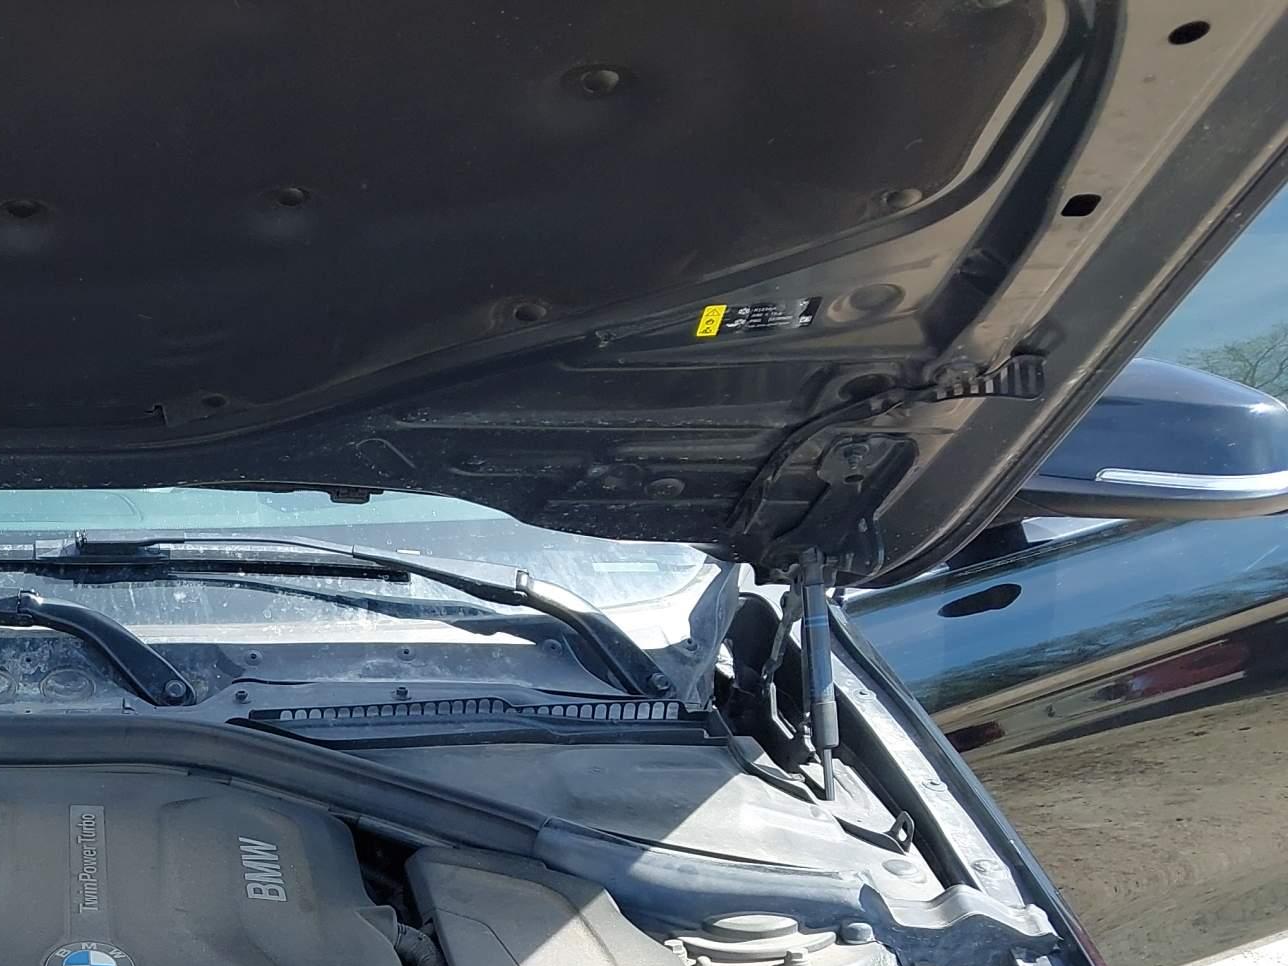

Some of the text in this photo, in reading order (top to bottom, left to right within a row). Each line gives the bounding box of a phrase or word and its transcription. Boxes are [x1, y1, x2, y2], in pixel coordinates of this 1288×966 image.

[77, 813, 99, 914] TwinPower Turbo
[238, 835, 289, 903] BMW
